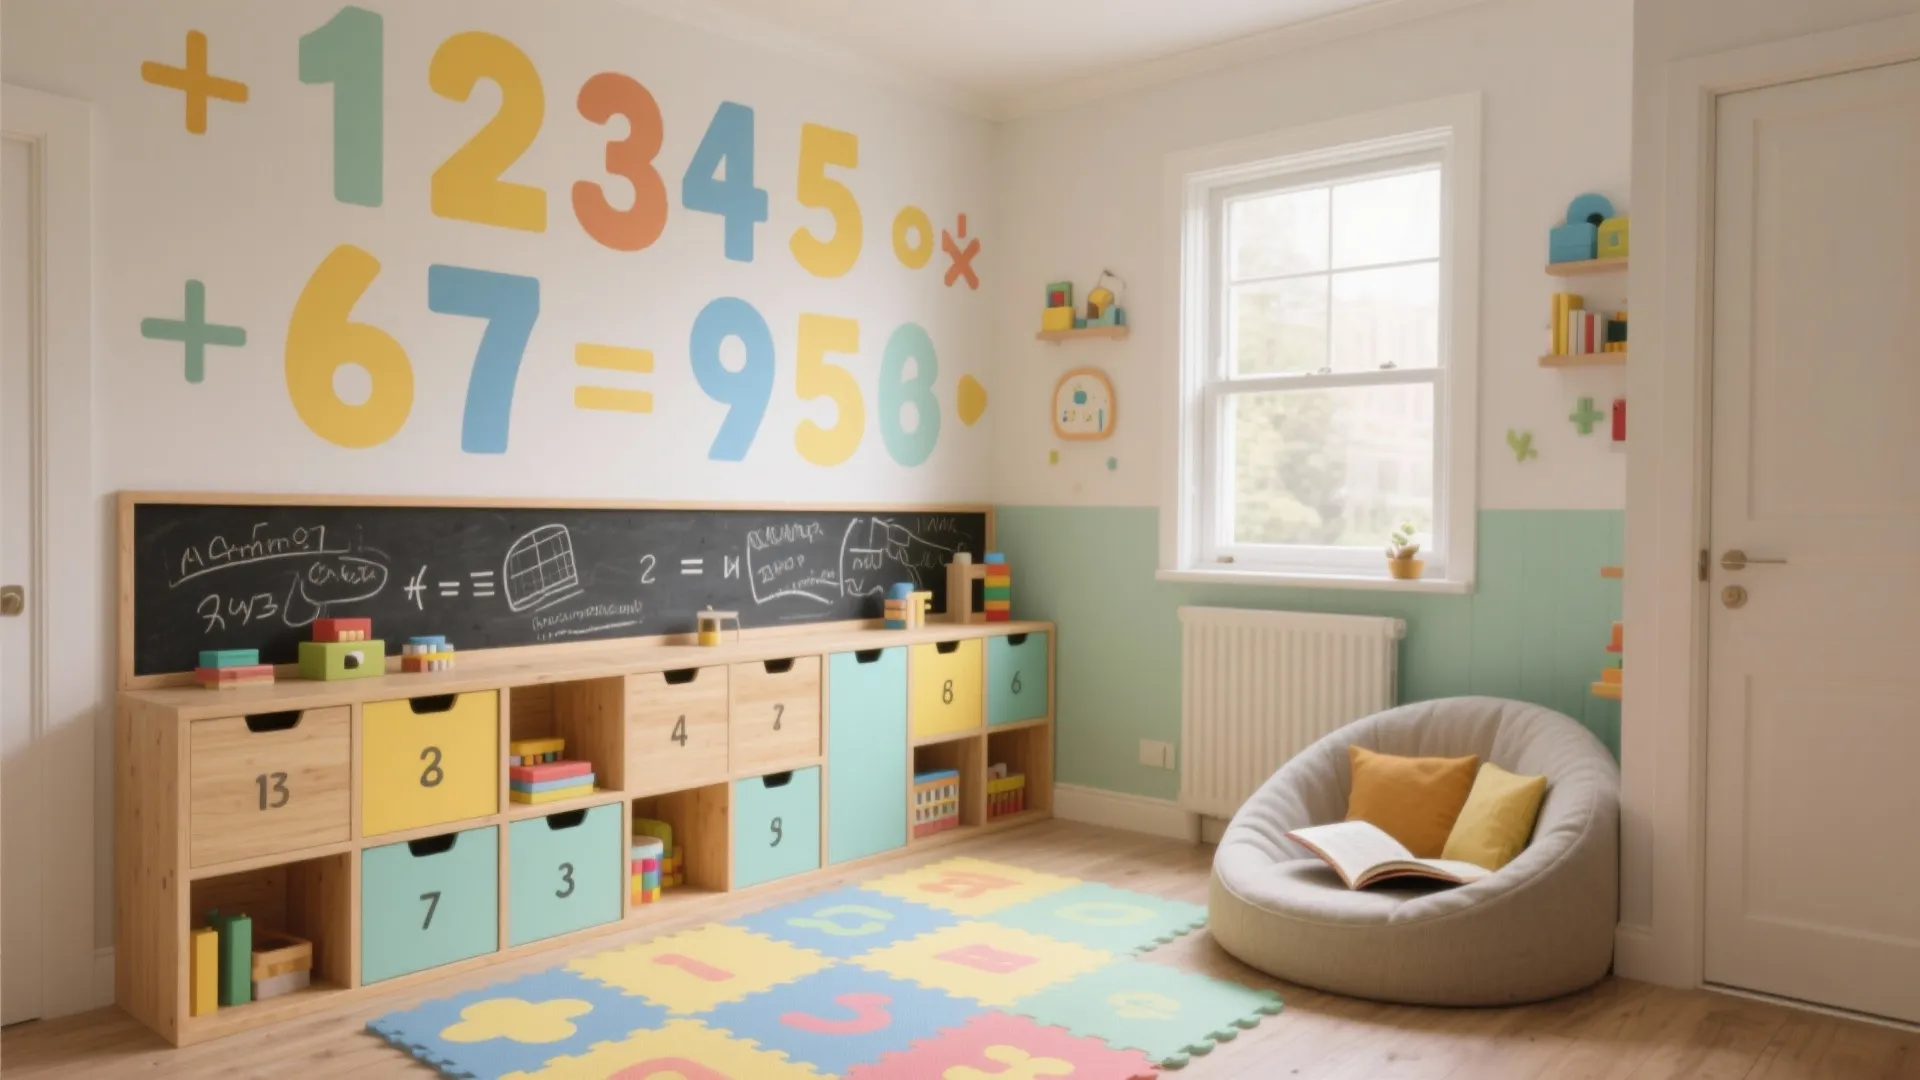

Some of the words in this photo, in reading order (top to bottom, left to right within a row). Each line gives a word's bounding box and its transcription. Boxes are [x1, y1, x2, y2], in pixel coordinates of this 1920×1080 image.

[1011, 670, 1022, 695] 6
[670, 714, 688, 747] 4
[255, 772, 290, 811] 13
[555, 862, 576, 899] 3
[419, 891, 442, 931] 7
